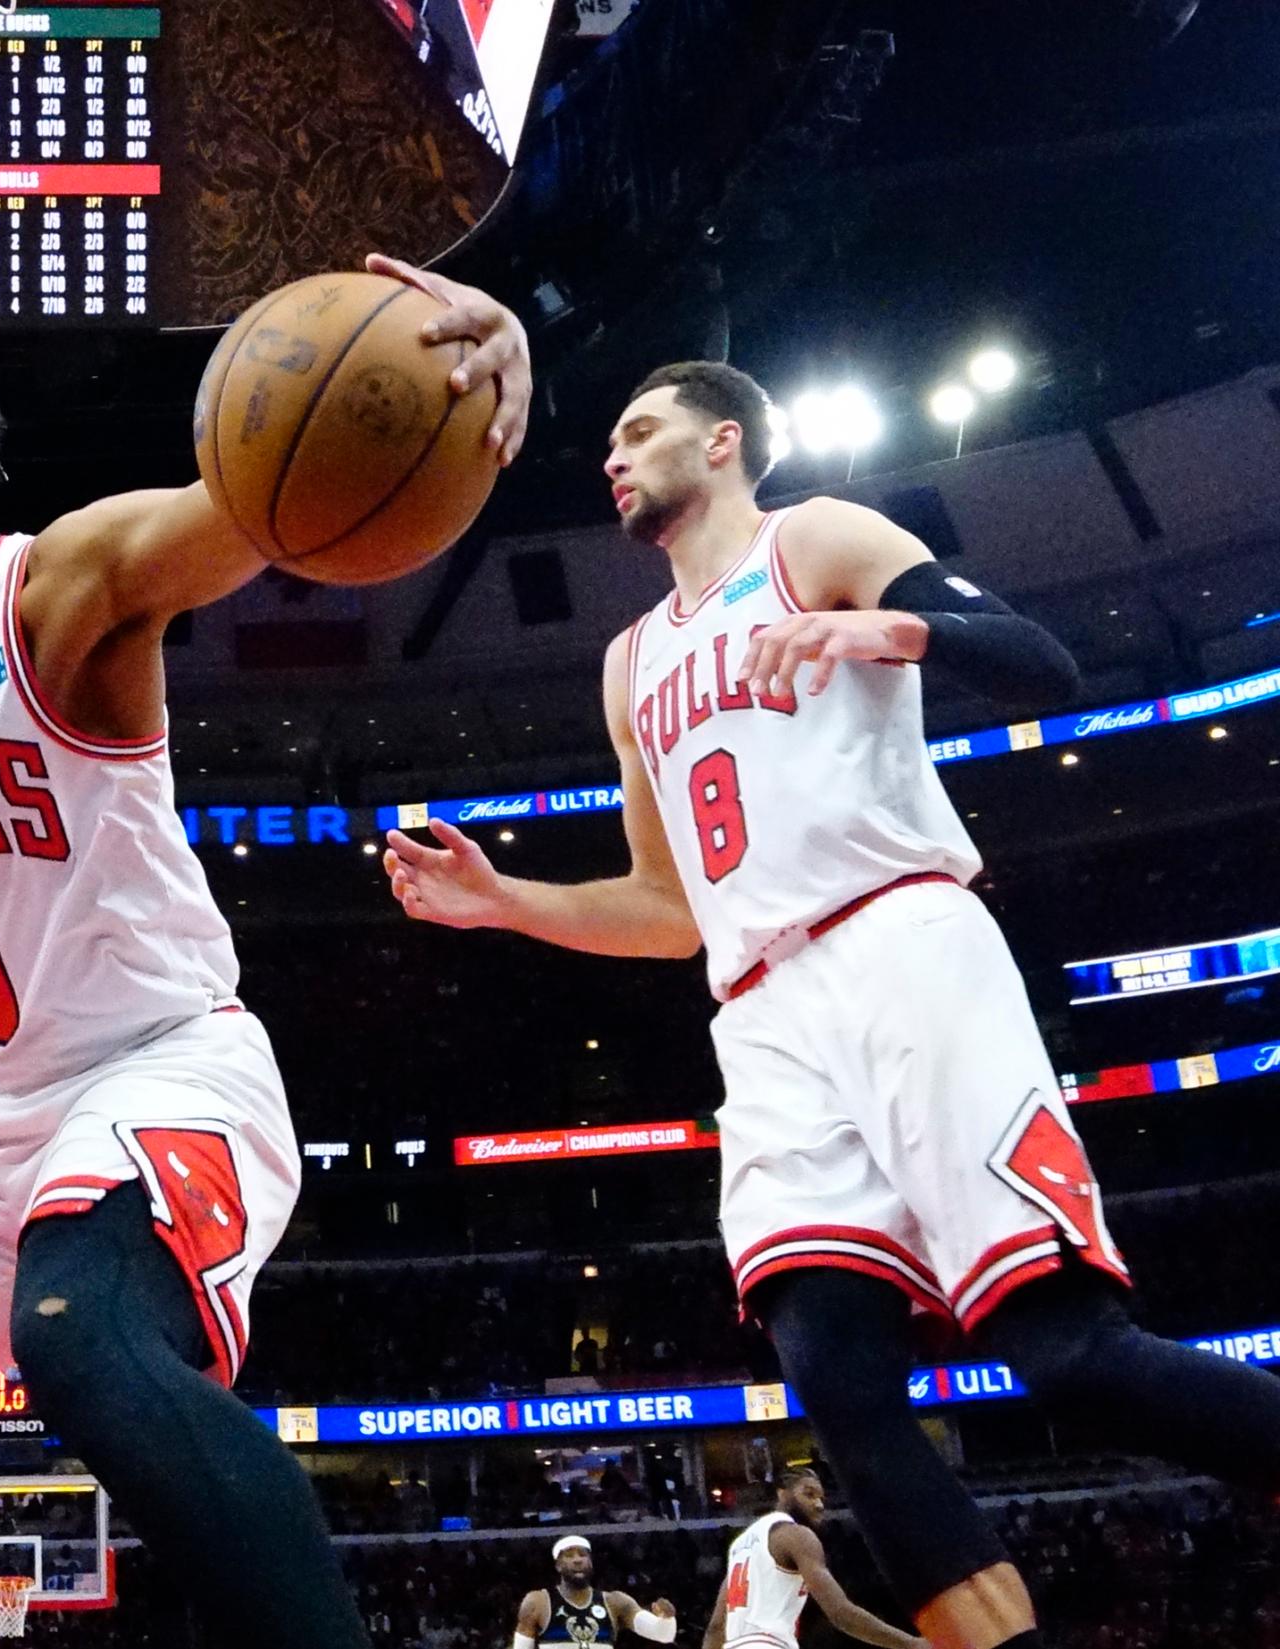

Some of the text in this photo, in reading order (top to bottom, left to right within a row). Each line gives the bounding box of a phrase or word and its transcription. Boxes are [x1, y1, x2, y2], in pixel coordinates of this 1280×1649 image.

[6, 14, 49, 31] BUCKS
[131, 41, 141, 51] FT
[44, 56, 60, 72] 1/2
[87, 55, 102, 72] 1/1
[12, 77, 18, 93] 1
[129, 77, 144, 94] 1/1
[87, 98, 104, 115] 1/2
[10, 120, 21, 136] 11
[11, 141, 19, 158] 2
[0, 172, 39, 188] BULLS
[131, 197, 141, 208] FT
[11, 234, 19, 250] 2
[126, 276, 145, 293] 2/2
[11, 297, 19, 313] 4
[126, 297, 145, 314] 4/4
[1173, 673, 1280, 716] BUD LIGH
[1074, 704, 1154, 737] Michelob
[929, 738, 973, 762] EER
[550, 788, 624, 812] ULTRA
[457, 797, 531, 822] Michelob
[689, 747, 748, 885] 8
[304, 1143, 349, 1156] TIMEOUTS
[395, 1140, 426, 1155] FOULS
[468, 1128, 686, 1160] Budweiser CHAMPIONS CLUB
[358, 1396, 694, 1435] SUPERIOR LIGHT BEER
